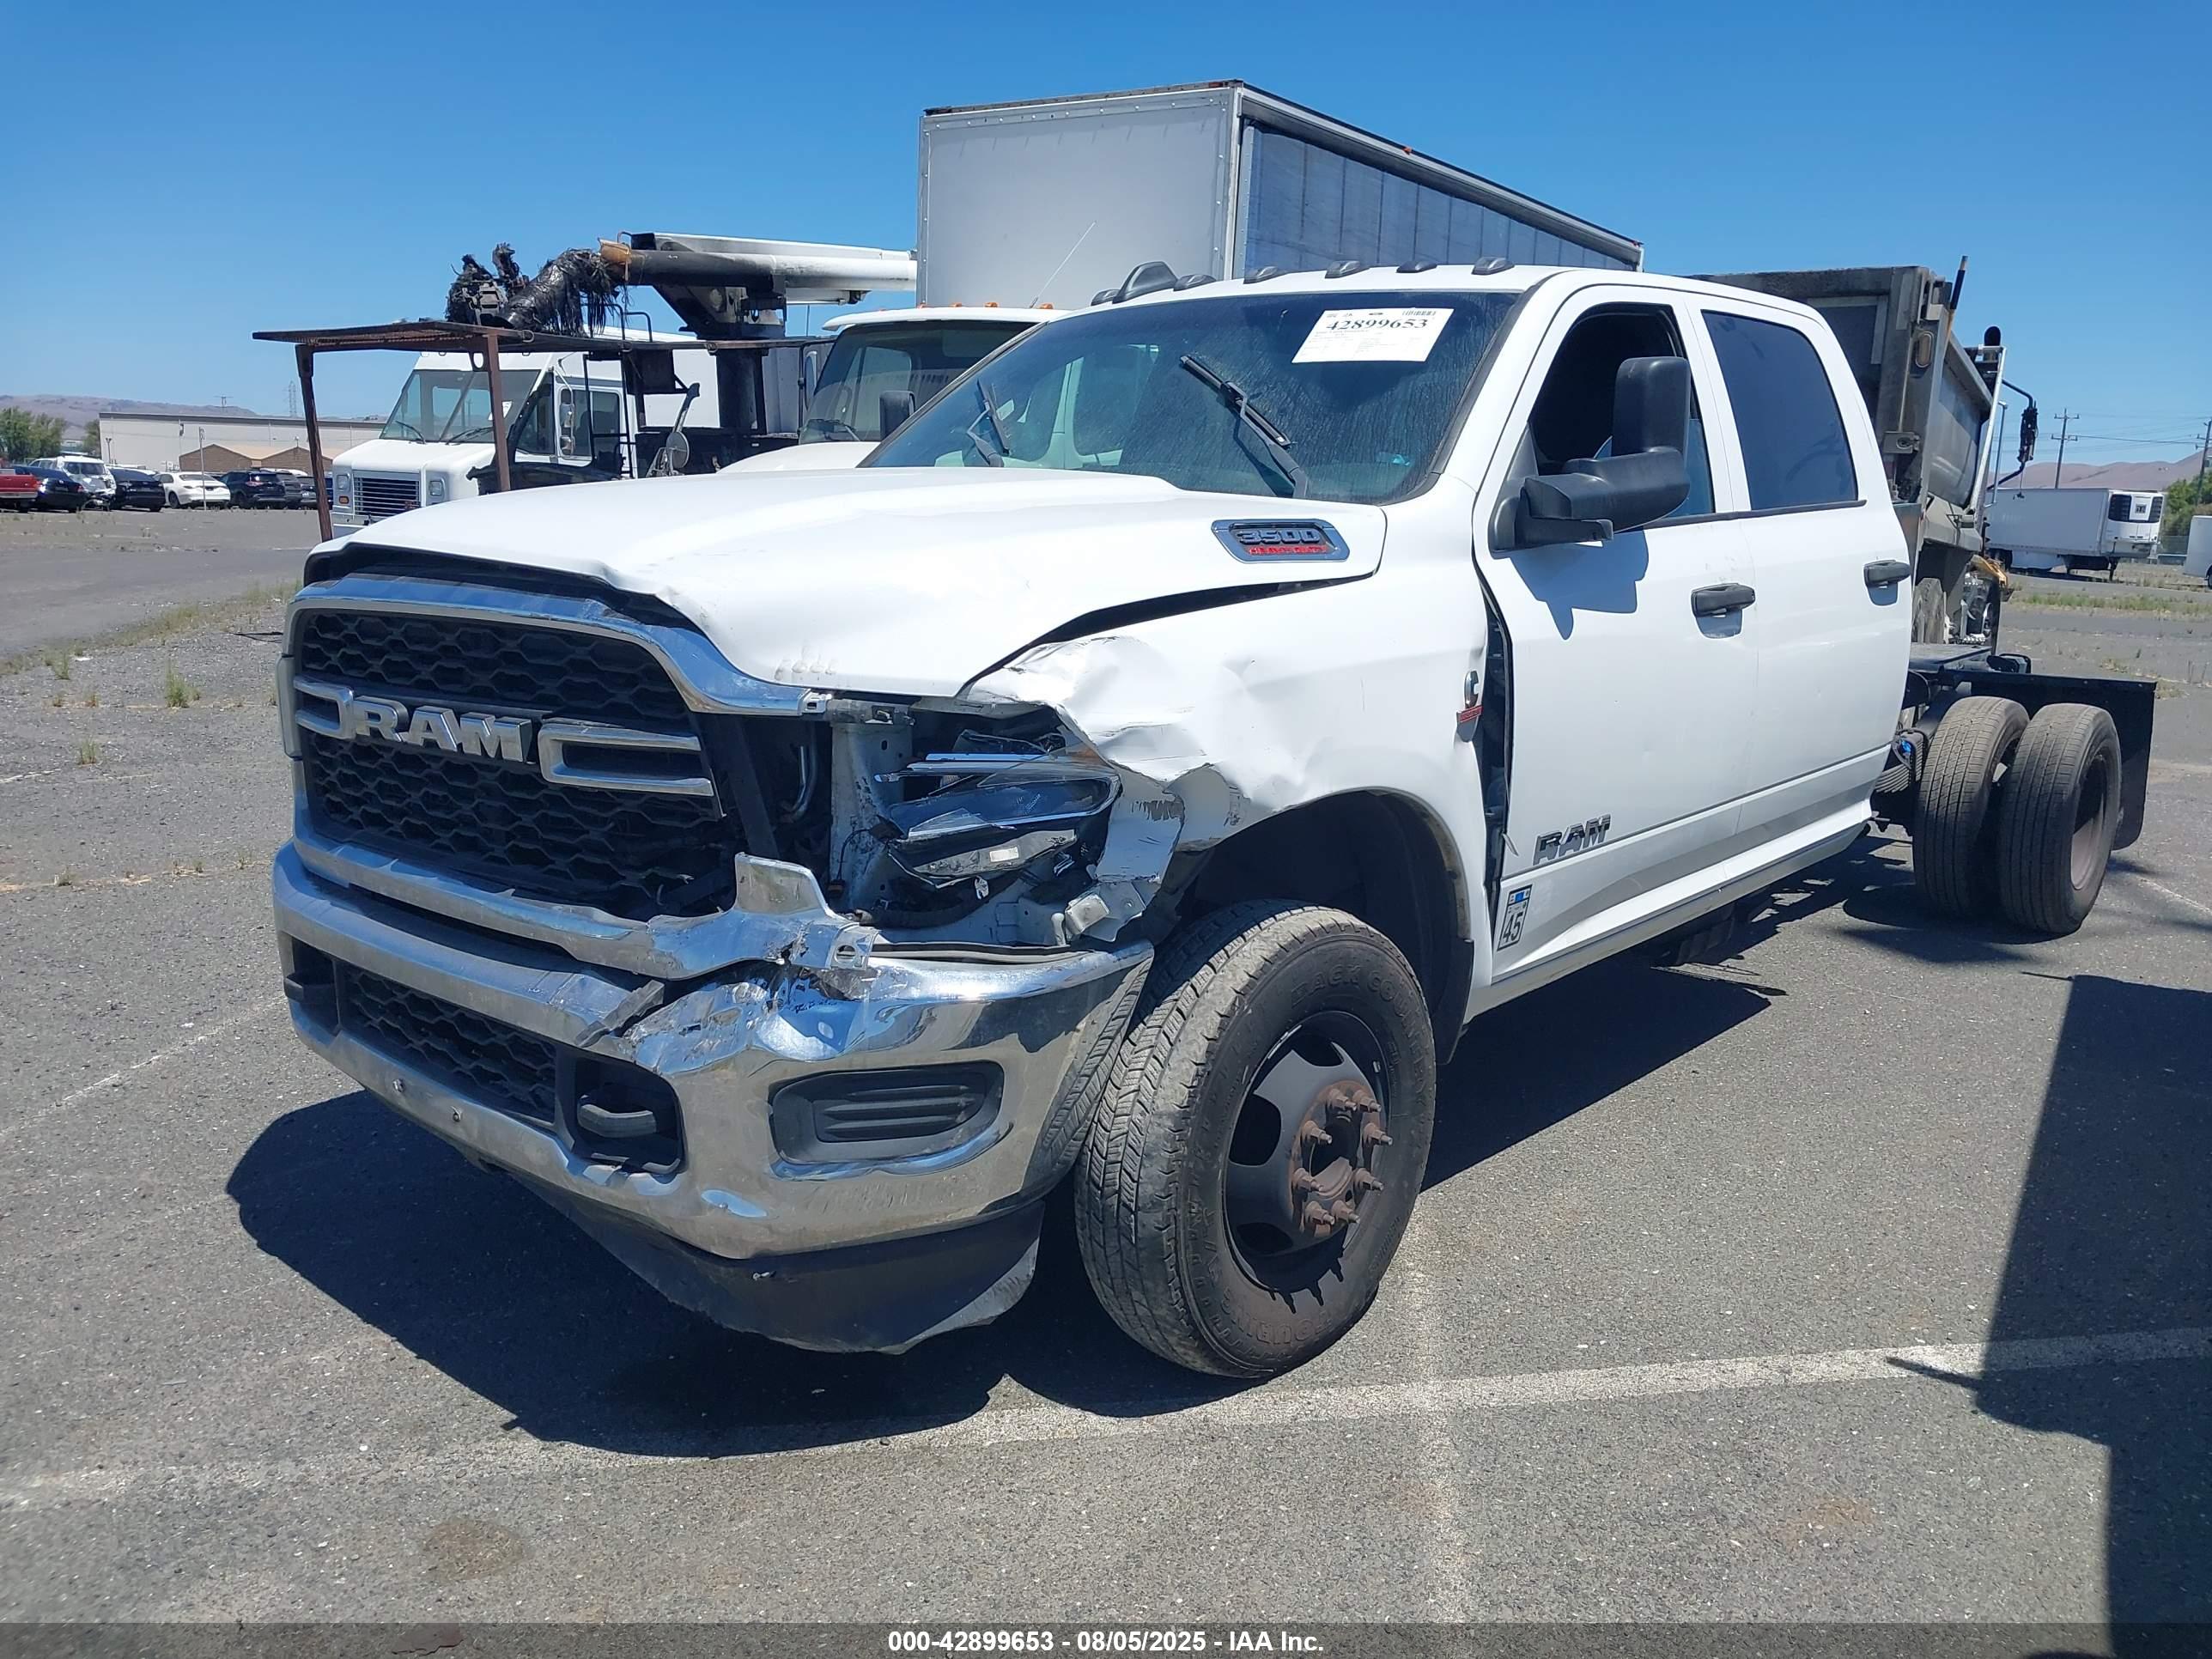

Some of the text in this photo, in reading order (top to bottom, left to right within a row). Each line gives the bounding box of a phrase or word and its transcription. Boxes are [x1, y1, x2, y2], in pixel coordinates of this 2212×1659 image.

[1327, 319, 1429, 331] 42899653
[1237, 529, 1321, 545] 3500
[353, 695, 532, 763] RAM
[1534, 815, 1611, 865] RAM
[1504, 912, 1523, 942] 45
